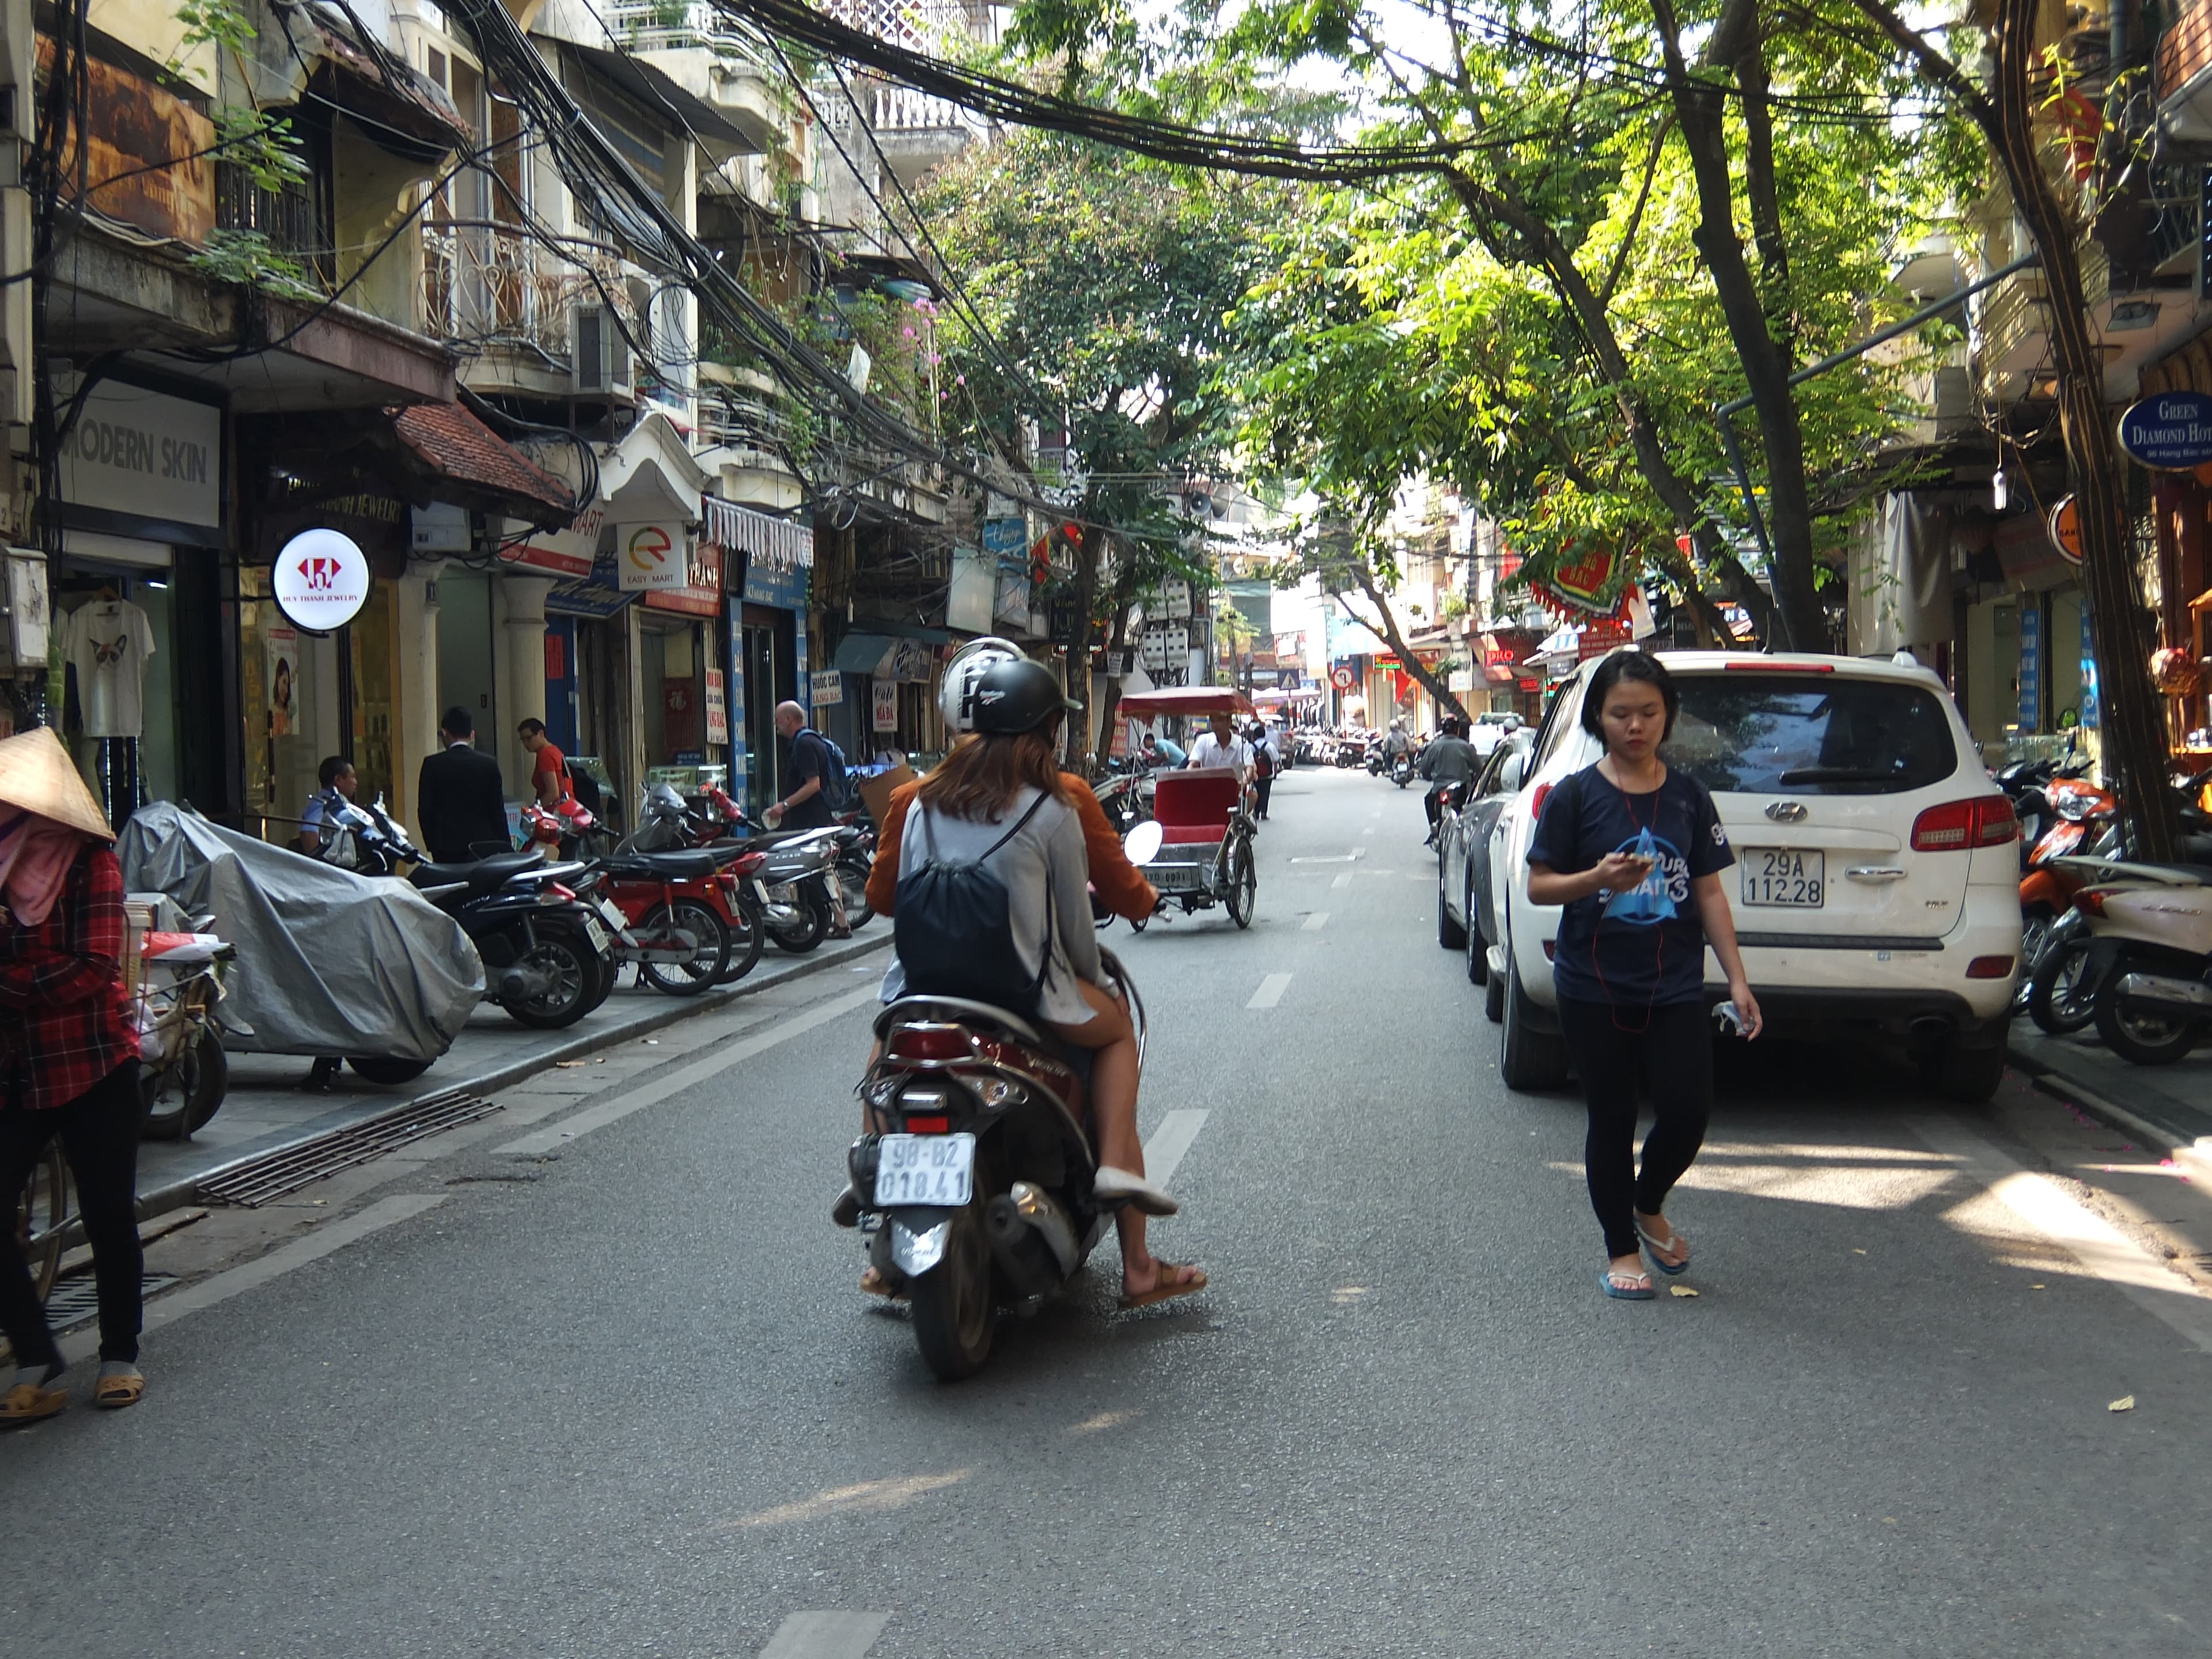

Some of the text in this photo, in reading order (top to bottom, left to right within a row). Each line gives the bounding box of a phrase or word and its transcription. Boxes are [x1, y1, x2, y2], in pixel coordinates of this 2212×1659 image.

[2133, 425, 2186, 445] DIAMOND
[161, 436, 207, 484] SKIN
[627, 574, 673, 584] EASY MART
[1763, 852, 1804, 877] 29A
[1748, 877, 1821, 903] 112.28
[893, 1141, 960, 1168] 98-B2
